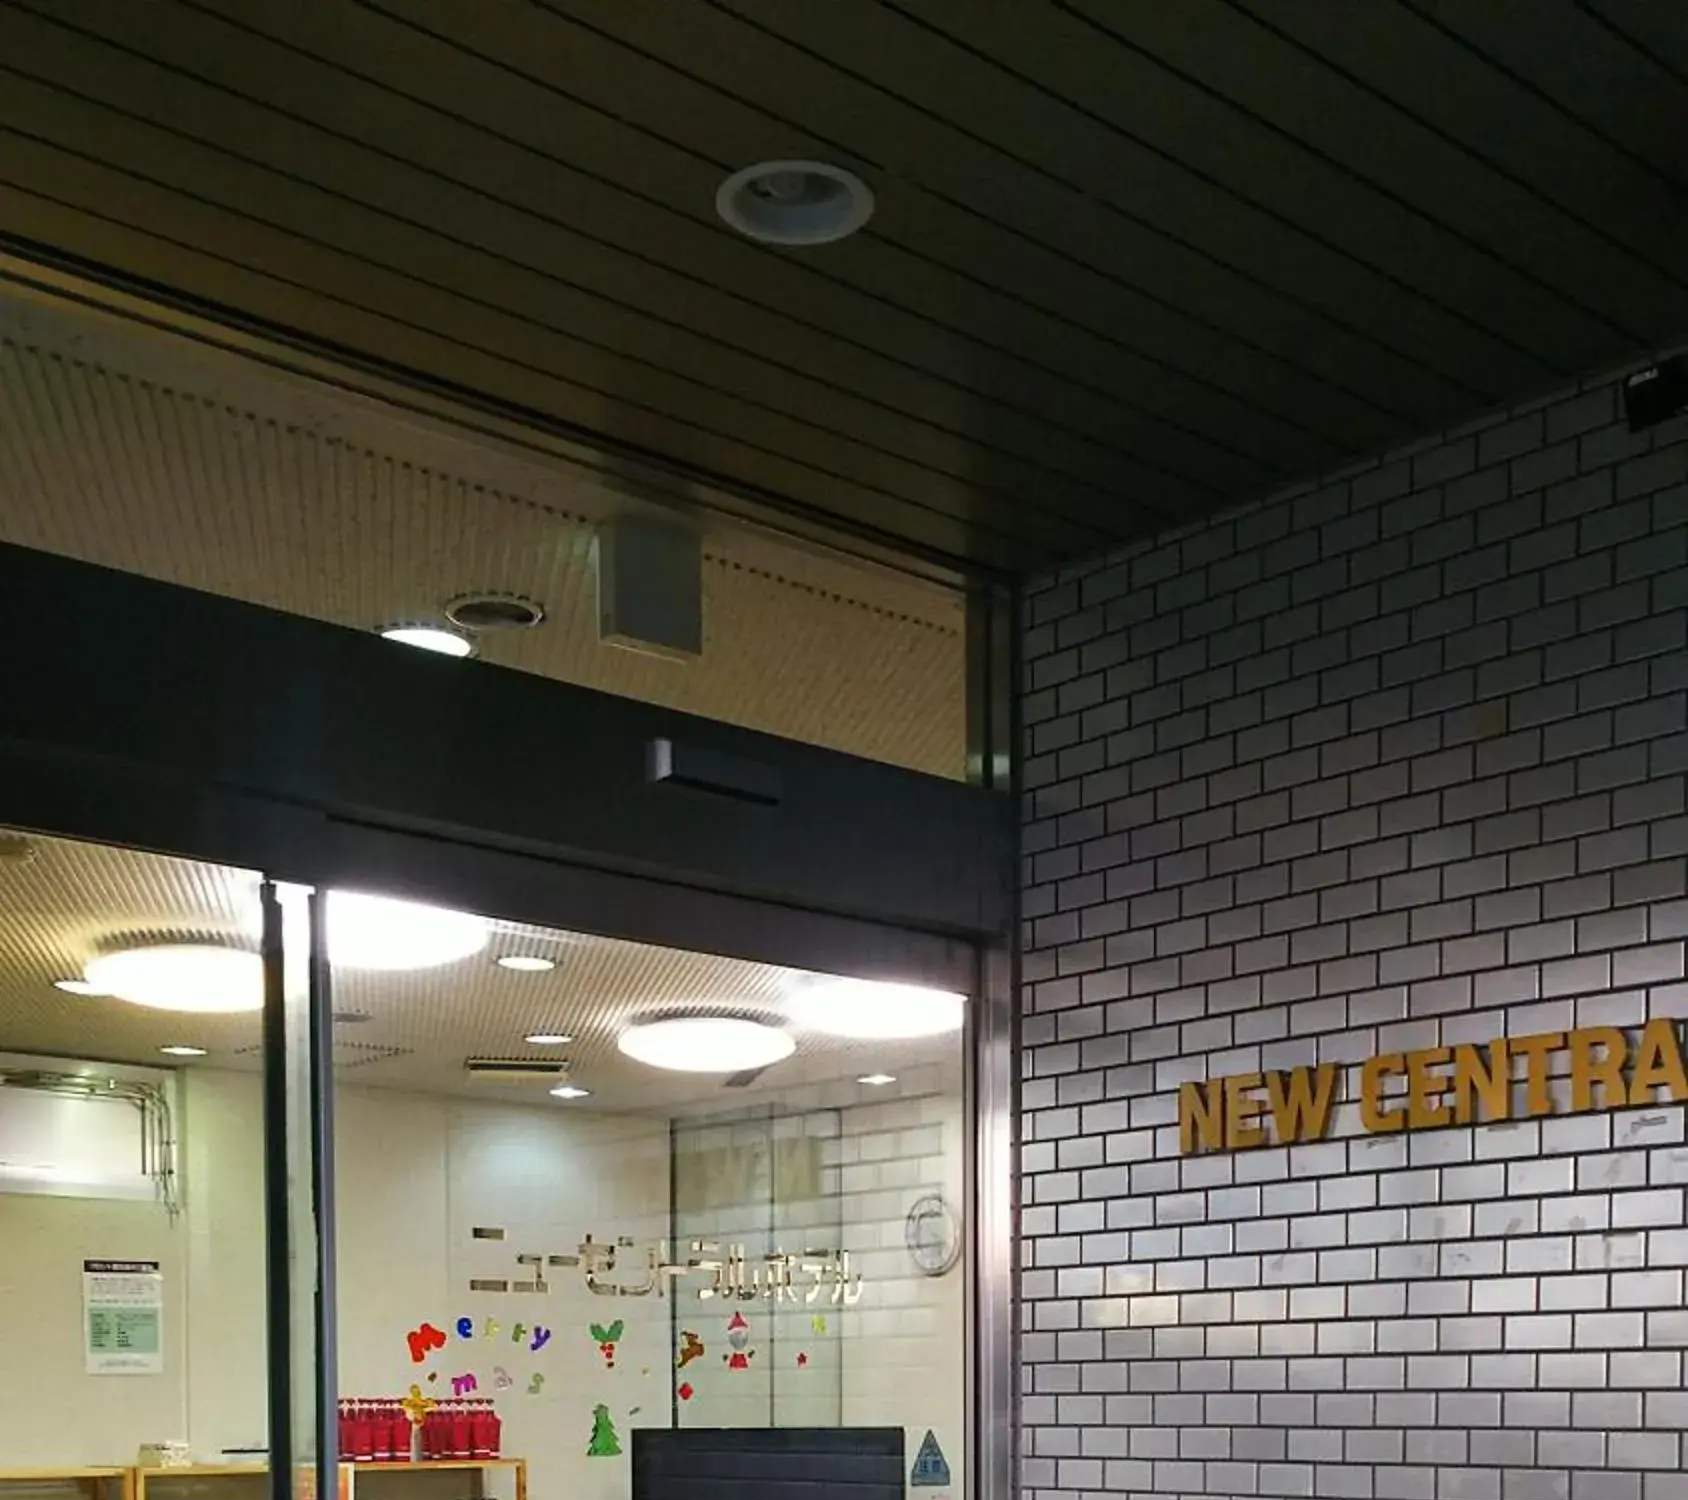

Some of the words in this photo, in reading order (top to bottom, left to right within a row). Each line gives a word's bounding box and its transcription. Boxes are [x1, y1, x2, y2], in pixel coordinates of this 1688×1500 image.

[1179, 1063, 1338, 1154] NEW
[1359, 1018, 1688, 1134] CENTRA
[470, 1227, 864, 1304] ニューセントラルホテル
[407, 1317, 551, 1363] Merry
